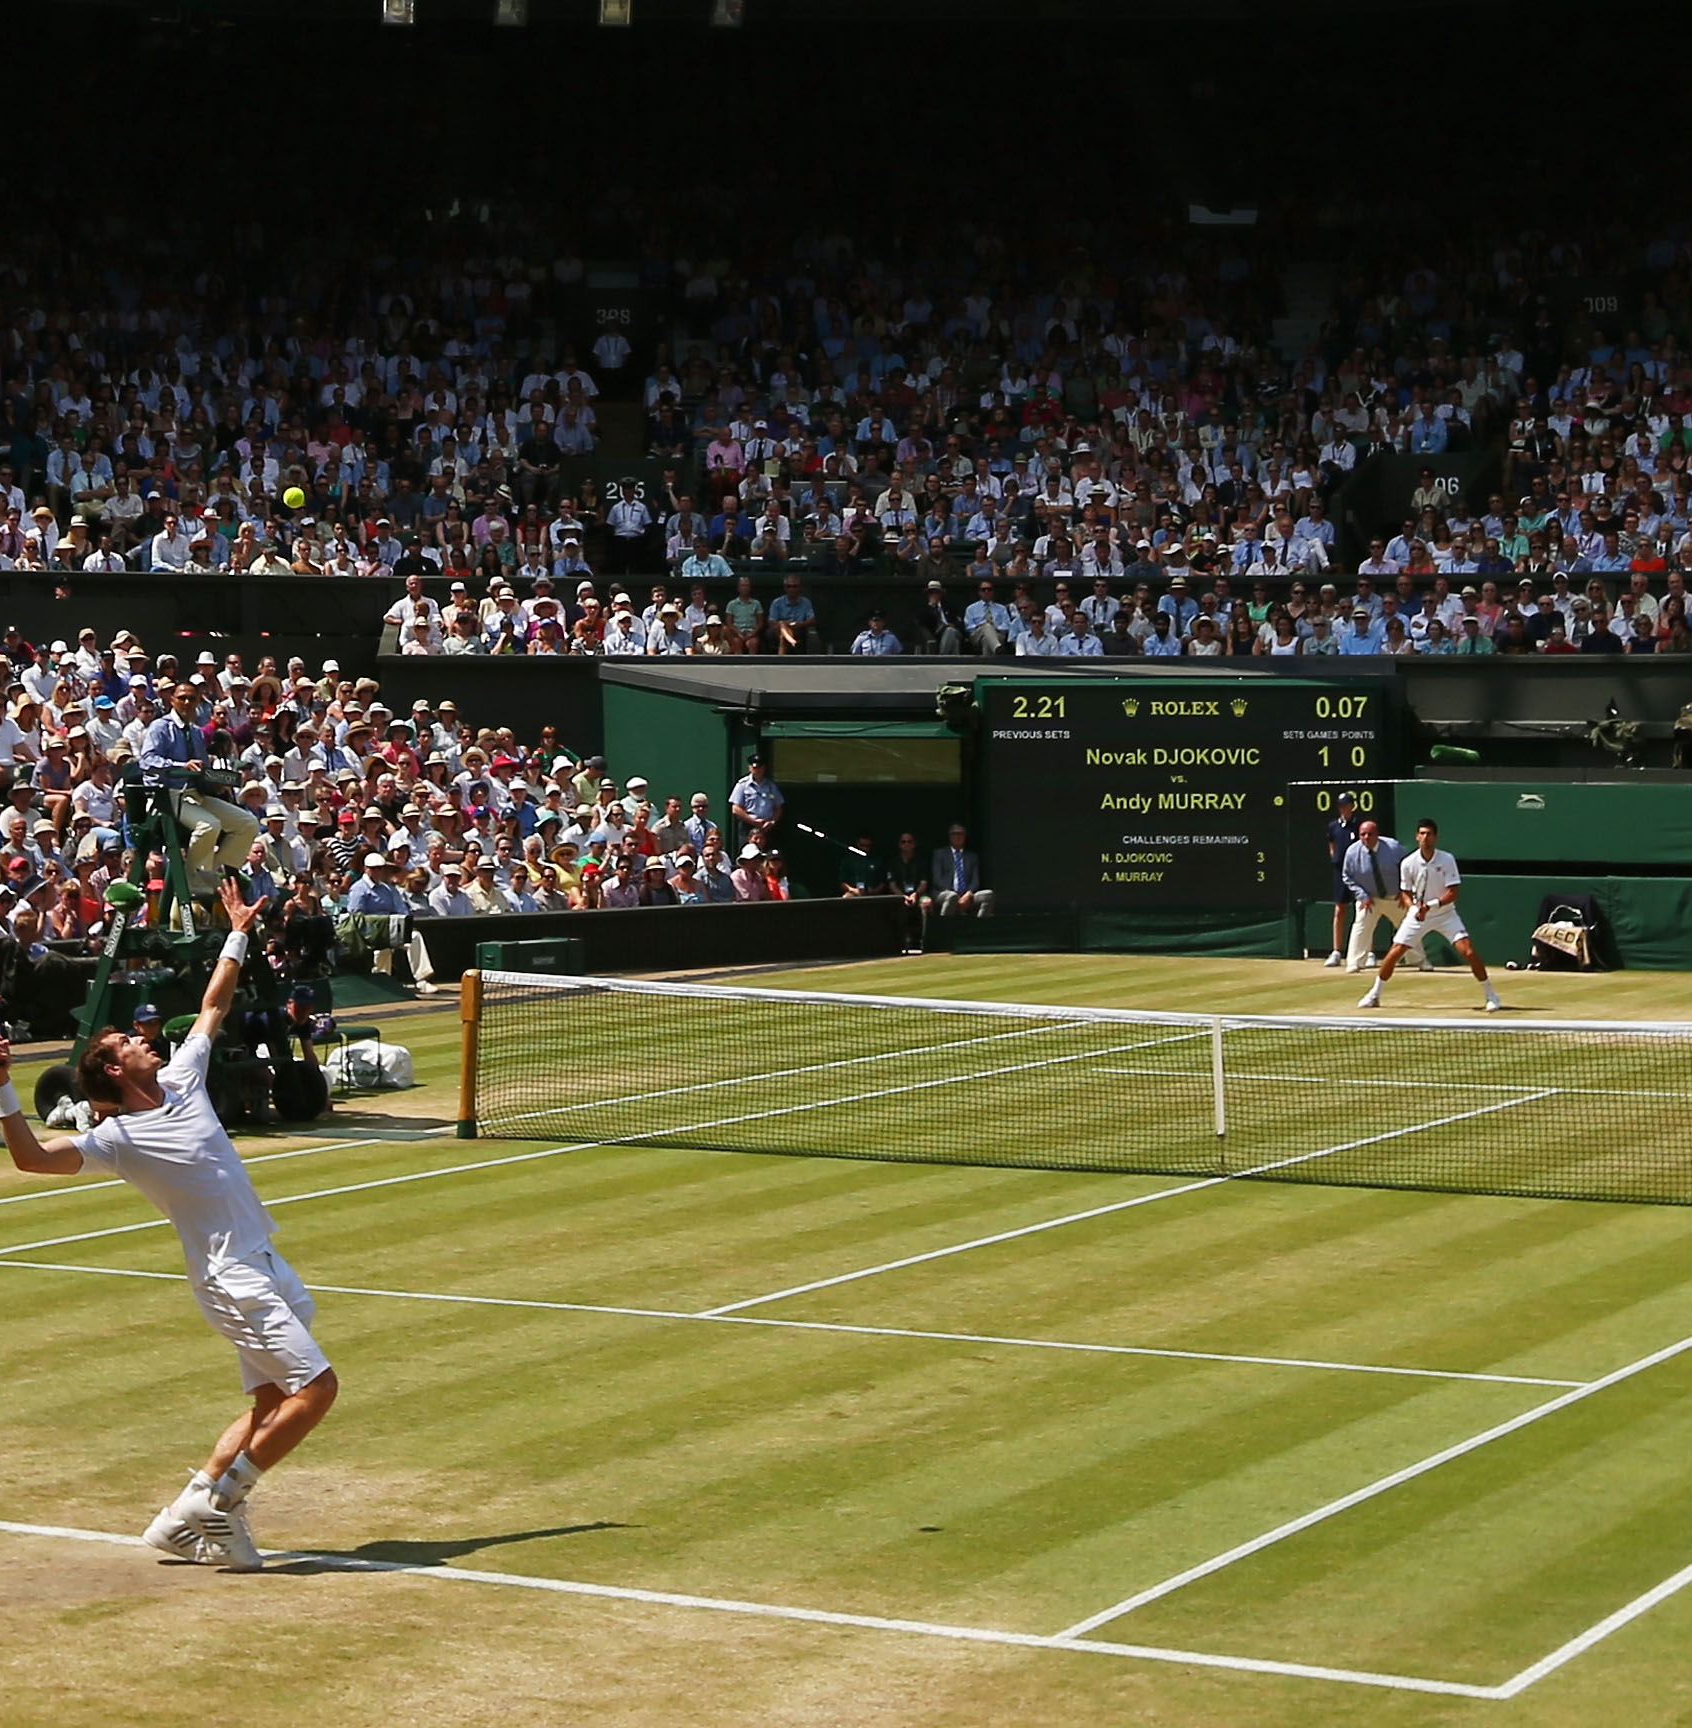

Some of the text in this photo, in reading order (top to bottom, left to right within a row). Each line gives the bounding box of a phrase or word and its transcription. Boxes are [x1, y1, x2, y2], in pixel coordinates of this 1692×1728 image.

[1013, 696, 1065, 718] 2.21
[1150, 701, 1220, 715] ROLEX
[1316, 696, 1368, 718] 0.07
[992, 730, 1070, 739] PREVIOUS SETS
[1283, 731, 1375, 739] SETS GAMES POINTS
[1086, 748, 1260, 765] Novak DJOKOVIC
[1318, 746, 1365, 767] 1 0
[1170, 775, 1188, 783] vs.
[1101, 793, 1247, 814] Andy MURRAY
[1316, 791, 1331, 812] 0
[1122, 836, 1249, 845] CHALLENGES REMAINING
[1101, 853, 1173, 863] N. DJOKOVIC
[1257, 852, 1265, 863] 3
[1101, 872, 1164, 882] A. MURRAY
[1257, 871, 1265, 882] 3
